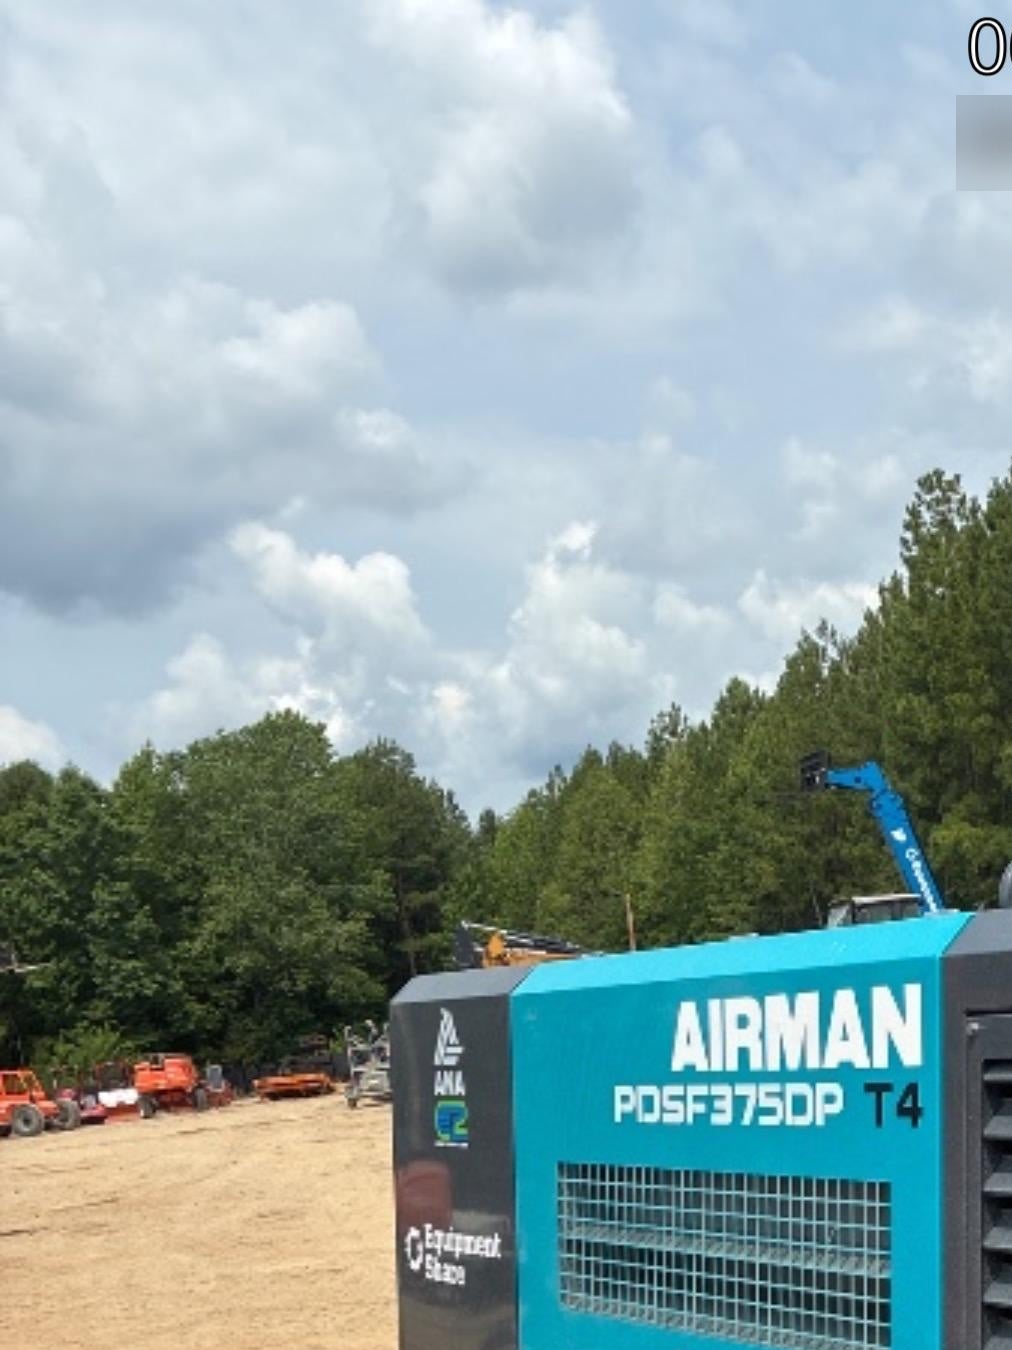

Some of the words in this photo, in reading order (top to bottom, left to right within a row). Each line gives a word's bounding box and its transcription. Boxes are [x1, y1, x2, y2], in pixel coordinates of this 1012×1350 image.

[671, 983, 923, 1073] AIRMAN
[613, 1082, 844, 1126] PDSF375DP
[864, 1082, 924, 1129] T4
[424, 1223, 502, 1259] Equipment
